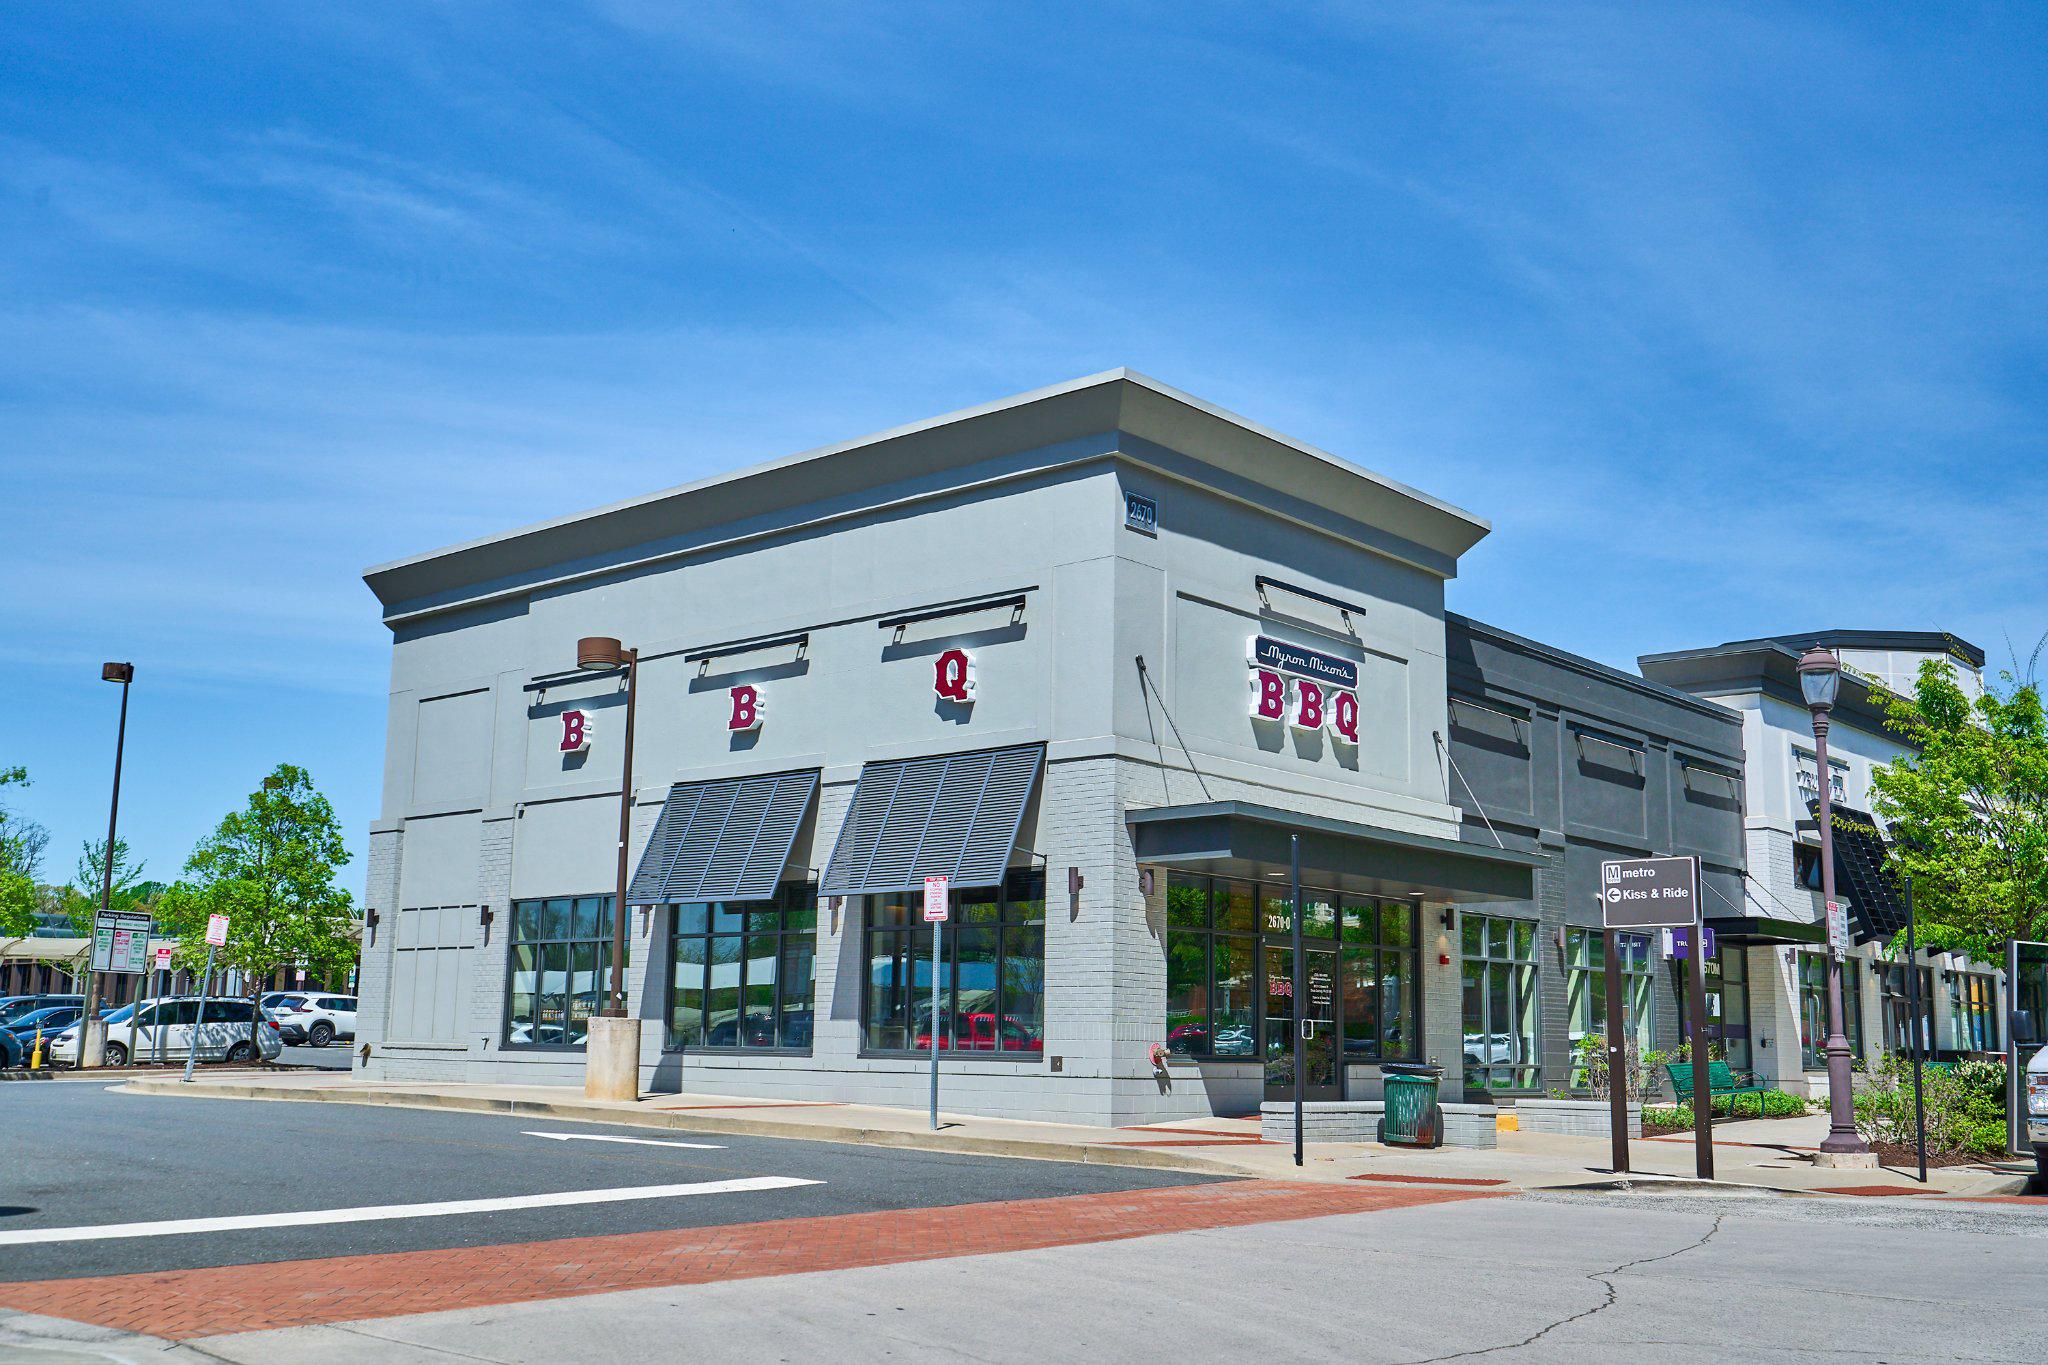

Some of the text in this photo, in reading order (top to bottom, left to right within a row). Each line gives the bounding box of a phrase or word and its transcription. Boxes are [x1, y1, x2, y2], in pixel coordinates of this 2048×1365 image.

[1130, 501, 1152, 524] 2670
[1260, 645, 1354, 679] Myron Mixon's
[559, 648, 976, 753] B B Q
[1256, 669, 1358, 743] BBQ
[1622, 868, 1656, 878] metro
[1623, 887, 1689, 900] Kiss & Ride
